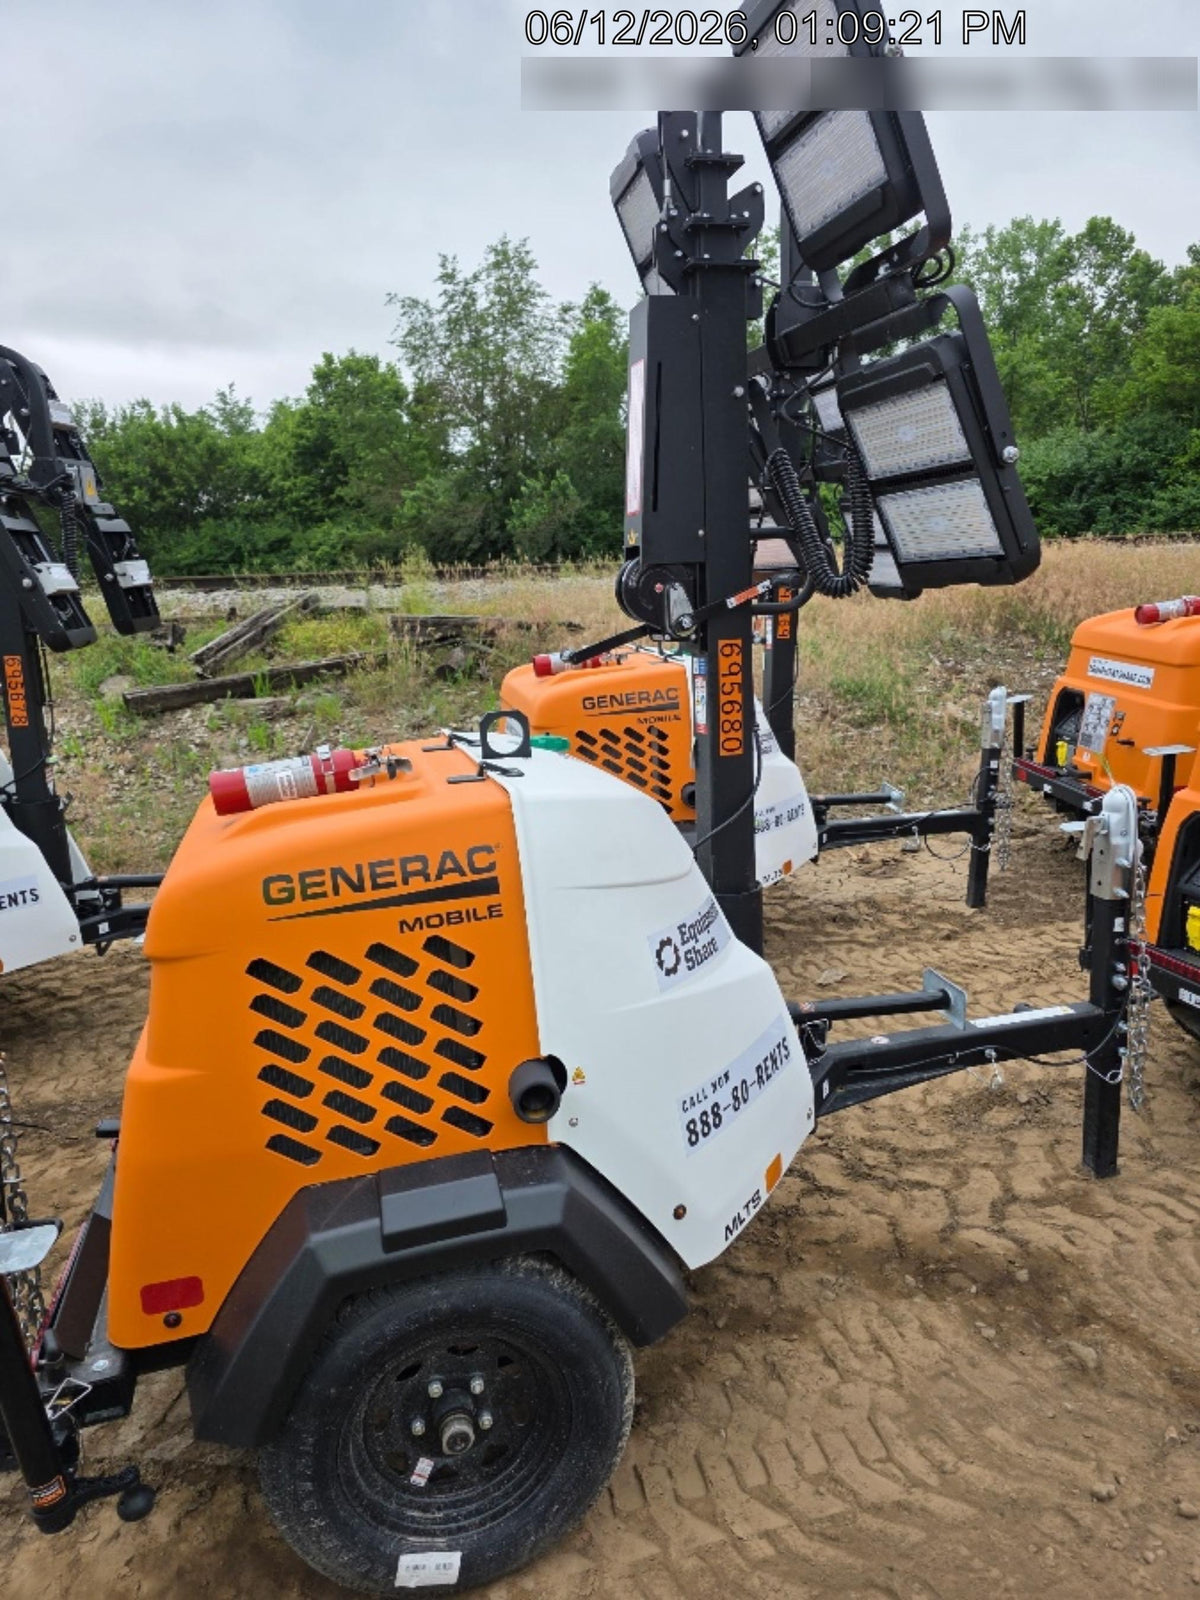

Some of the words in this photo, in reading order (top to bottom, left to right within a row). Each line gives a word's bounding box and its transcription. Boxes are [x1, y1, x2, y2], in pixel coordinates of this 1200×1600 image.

[6, 657, 27, 724] 695678
[582, 687, 679, 710] GENERAC
[720, 643, 742, 752] 695680
[262, 844, 497, 905] GENERAC
[399, 903, 504, 933] MOBILE
[682, 1088, 708, 1113] CALL
[711, 1070, 730, 1094] NOW
[686, 1036, 790, 1147] 888-80-RENTS
